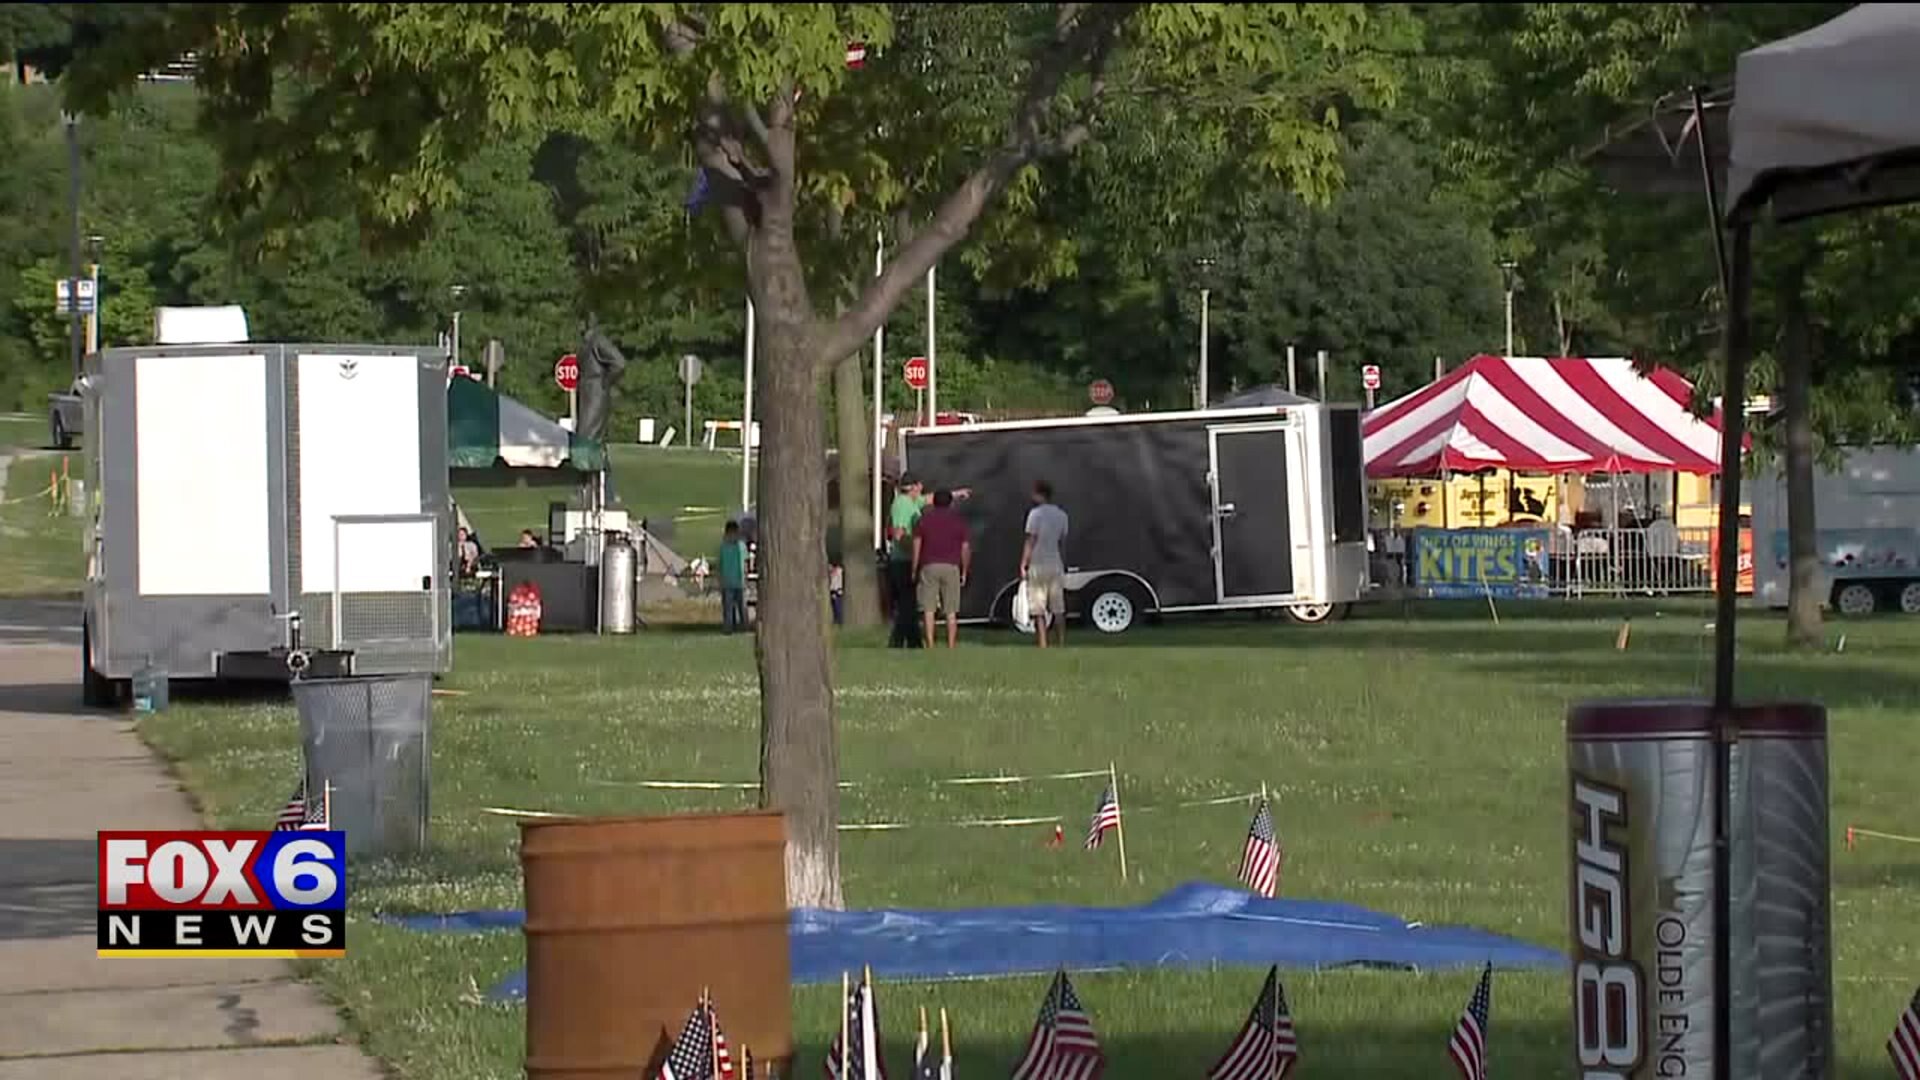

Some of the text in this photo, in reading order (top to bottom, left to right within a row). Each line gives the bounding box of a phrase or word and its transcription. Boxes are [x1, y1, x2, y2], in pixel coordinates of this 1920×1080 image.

[558, 366, 578, 379] STO
[906, 366, 925, 379] STO
[1420, 547, 1515, 581] KITES
[1656, 917, 1686, 1004] OLDE
